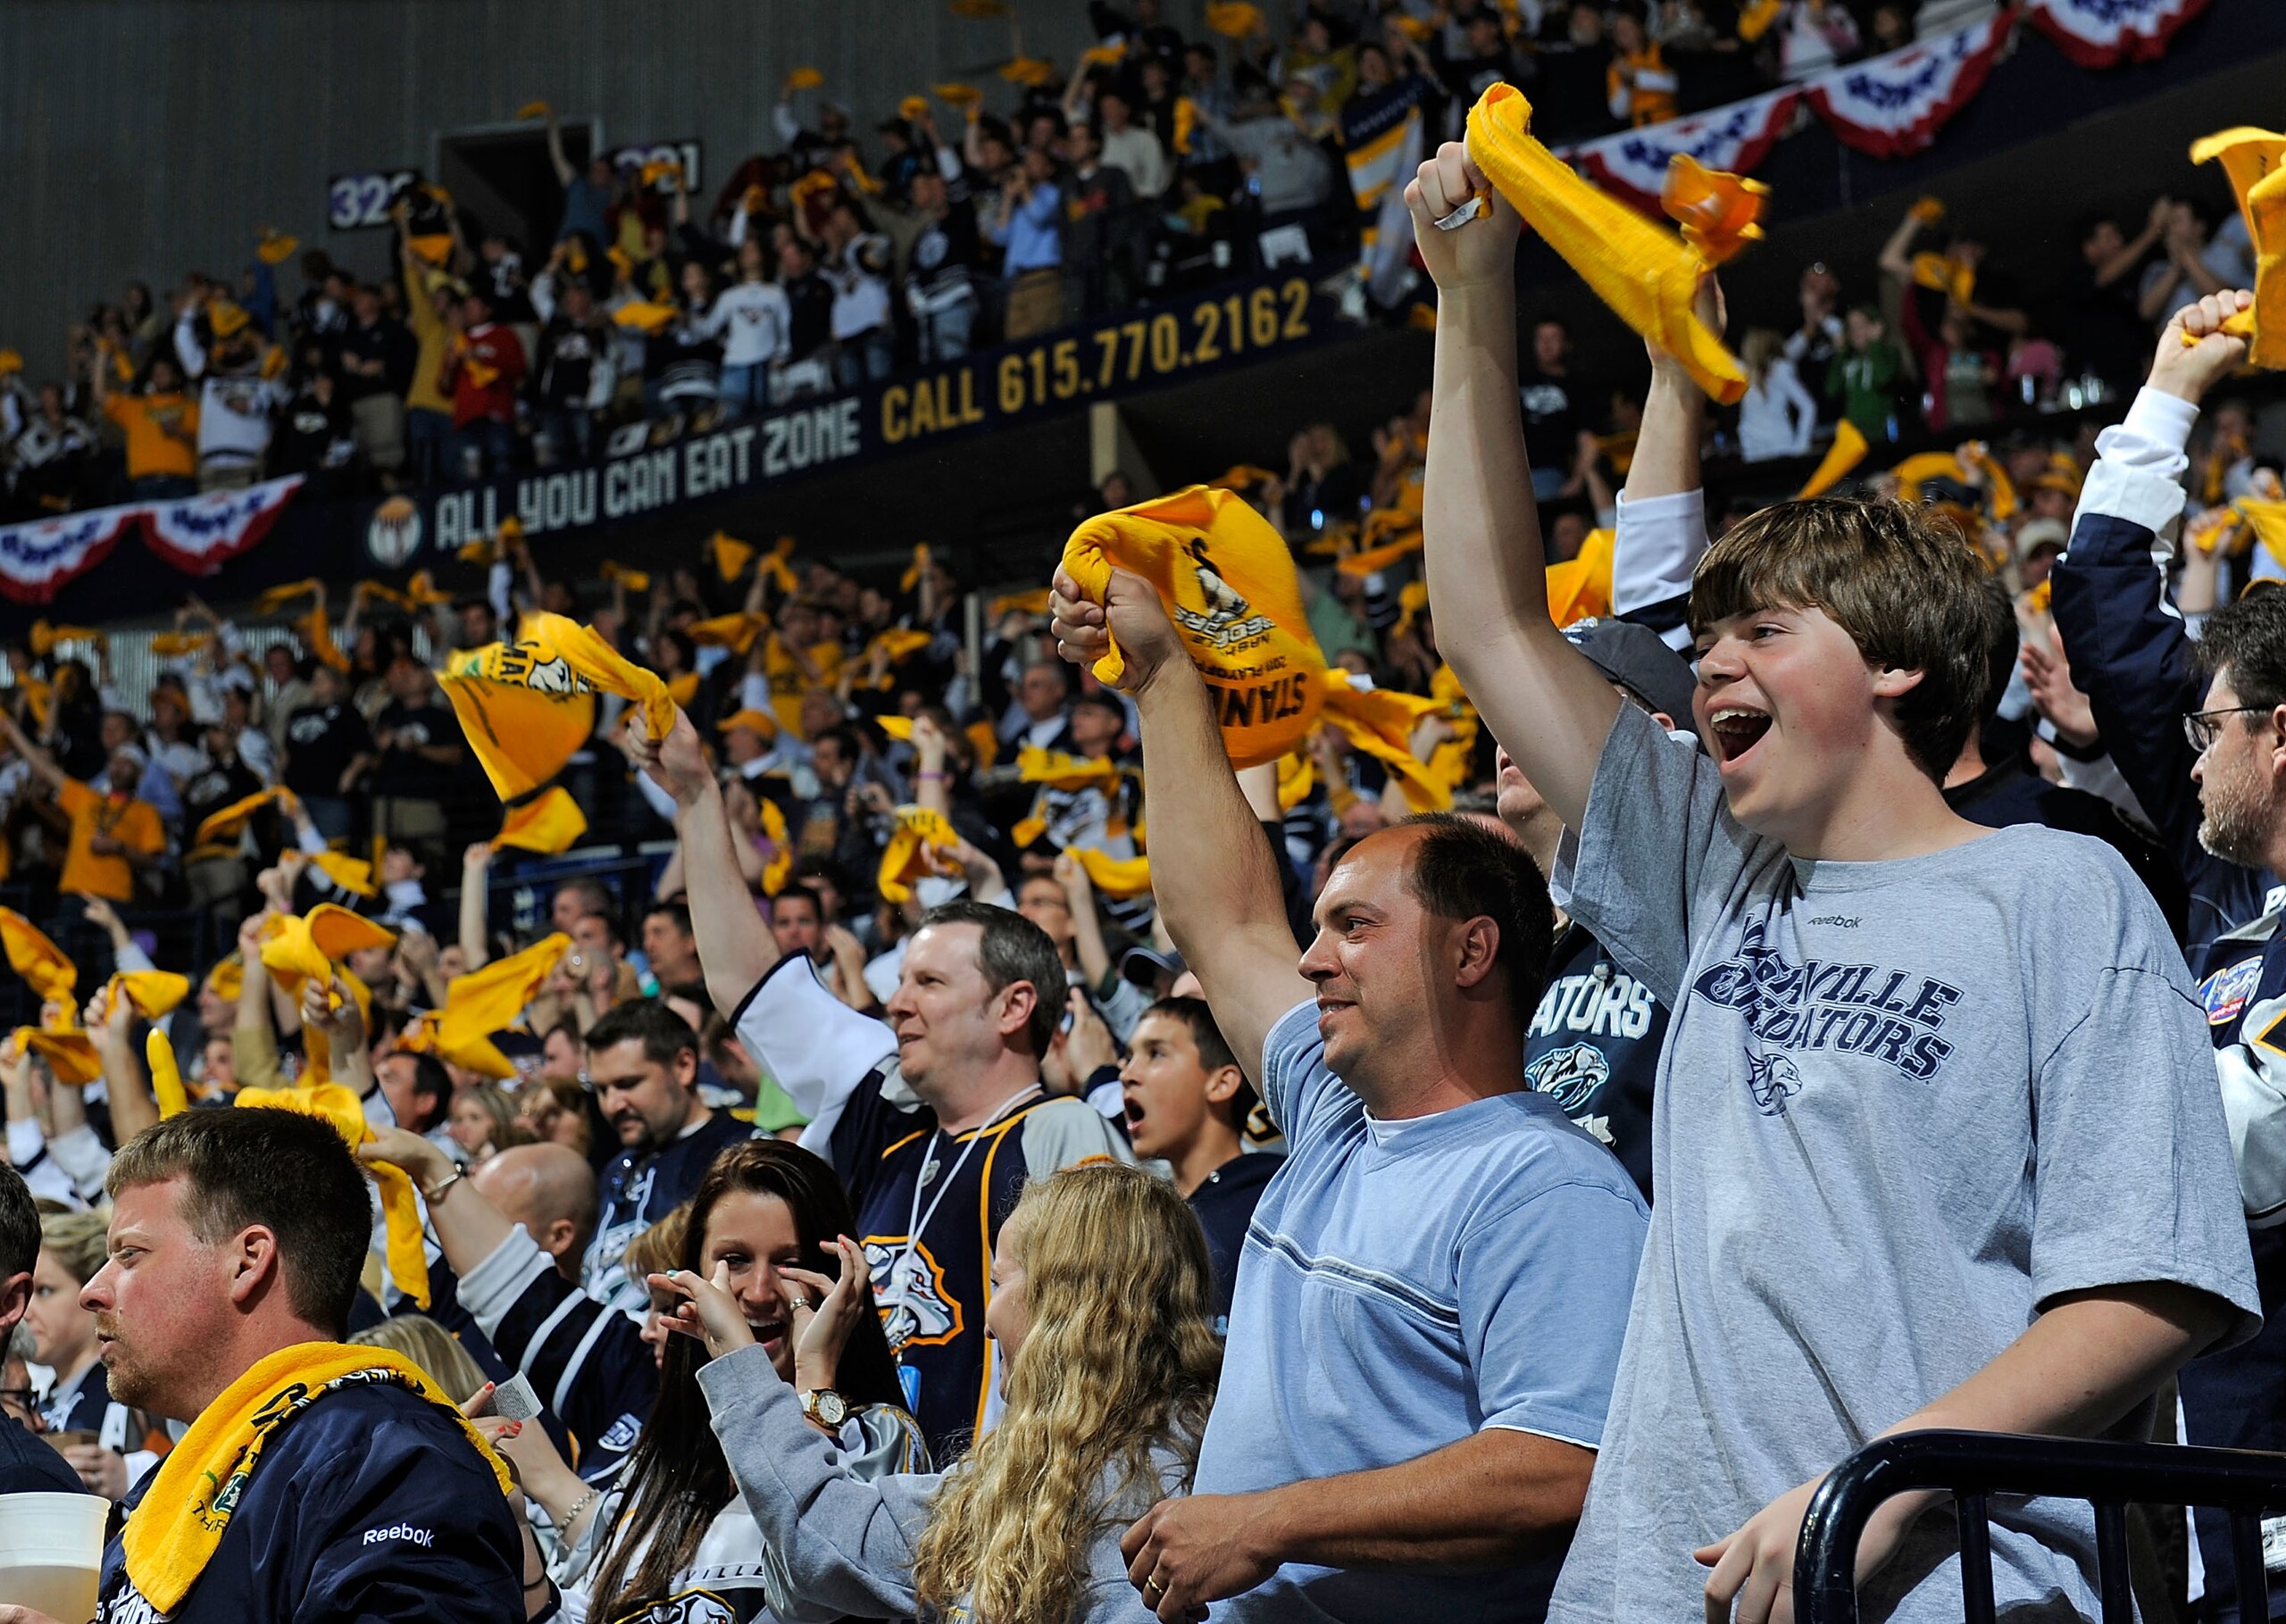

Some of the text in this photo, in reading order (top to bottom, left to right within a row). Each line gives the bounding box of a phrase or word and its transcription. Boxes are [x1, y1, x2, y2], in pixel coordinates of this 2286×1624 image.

[330, 171, 414, 229] 32
[435, 278, 1311, 551] ALL YOU CAN EAT ZONE CALL 615.770.2162
[1807, 915, 1863, 929] Reebok
[1515, 974, 1656, 1040] ATORS
[363, 1522, 435, 1548] Reebok
